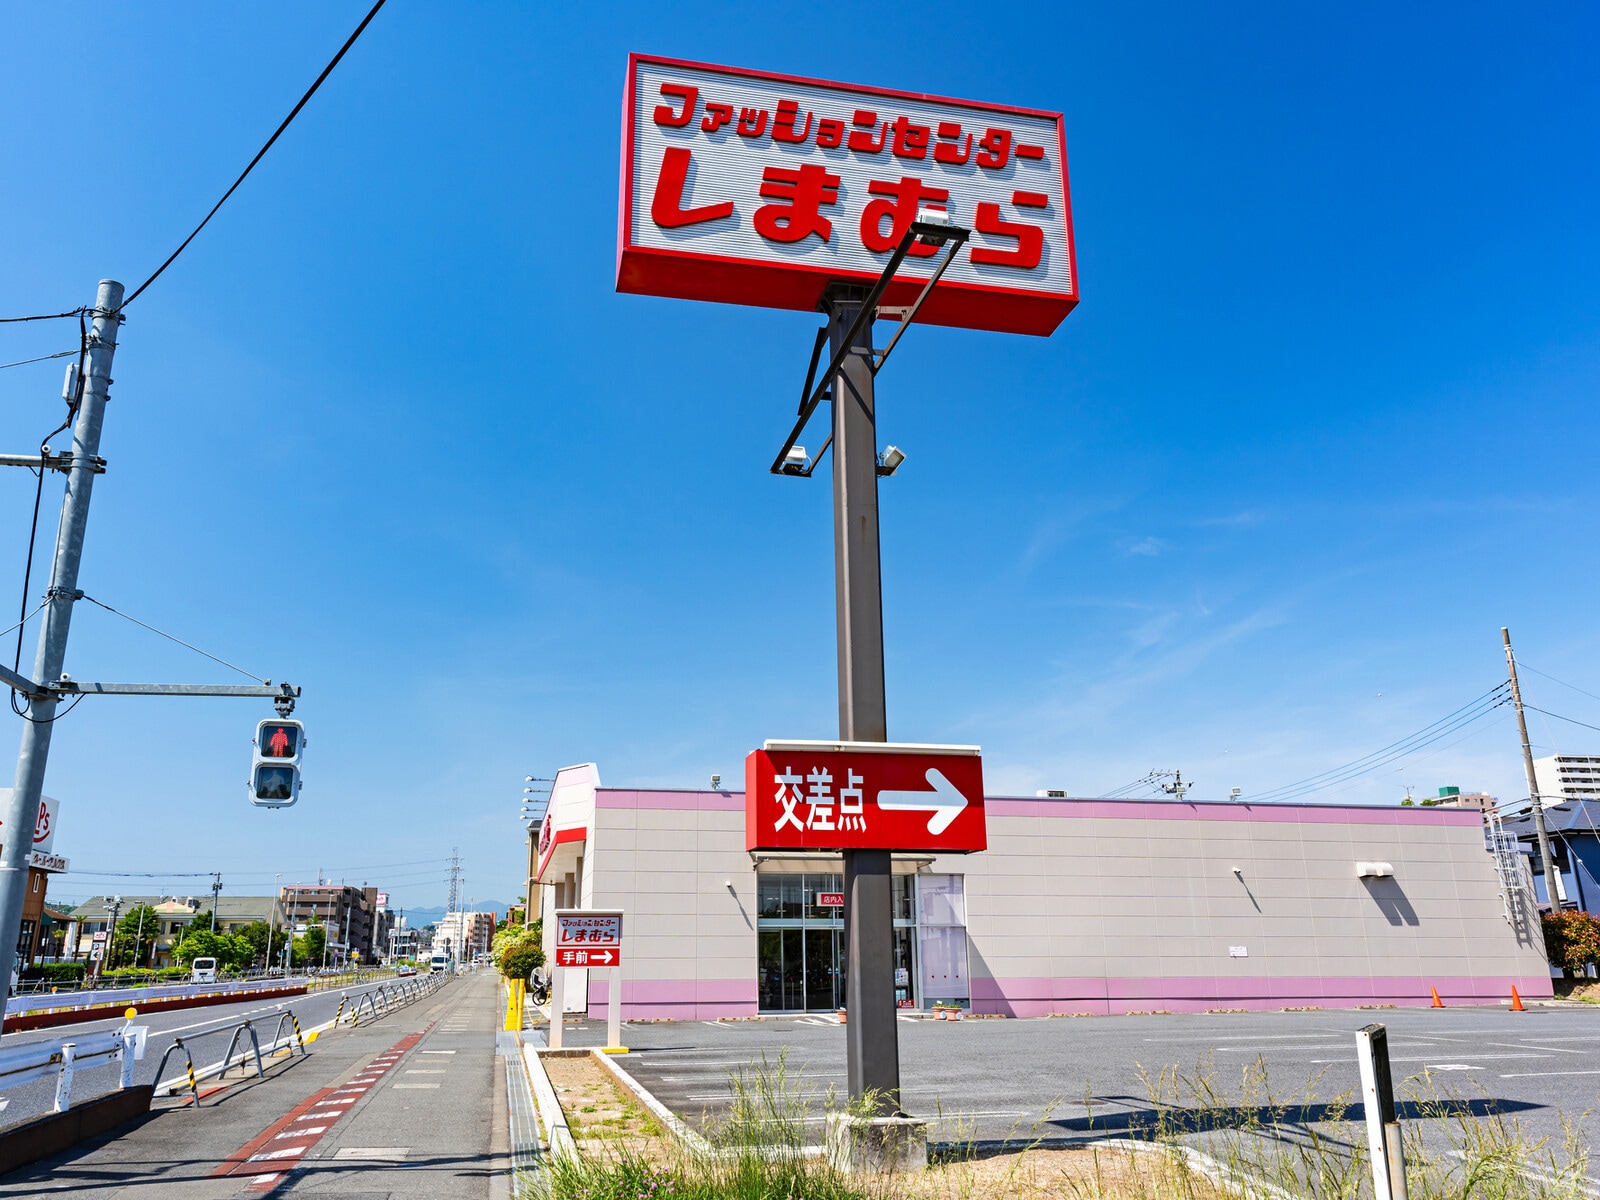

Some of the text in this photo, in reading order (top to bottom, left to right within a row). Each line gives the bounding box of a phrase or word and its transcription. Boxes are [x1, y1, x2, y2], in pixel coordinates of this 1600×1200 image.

[653, 83, 1044, 169] ファッションセンター
[651, 146, 1048, 269] しまむら
[774, 766, 867, 832] 交差点
[823, 895, 844, 904] 店内入
[562, 919, 616, 927] ファッションセンター
[562, 929, 616, 943] しまむら
[562, 951, 588, 964] 手前
